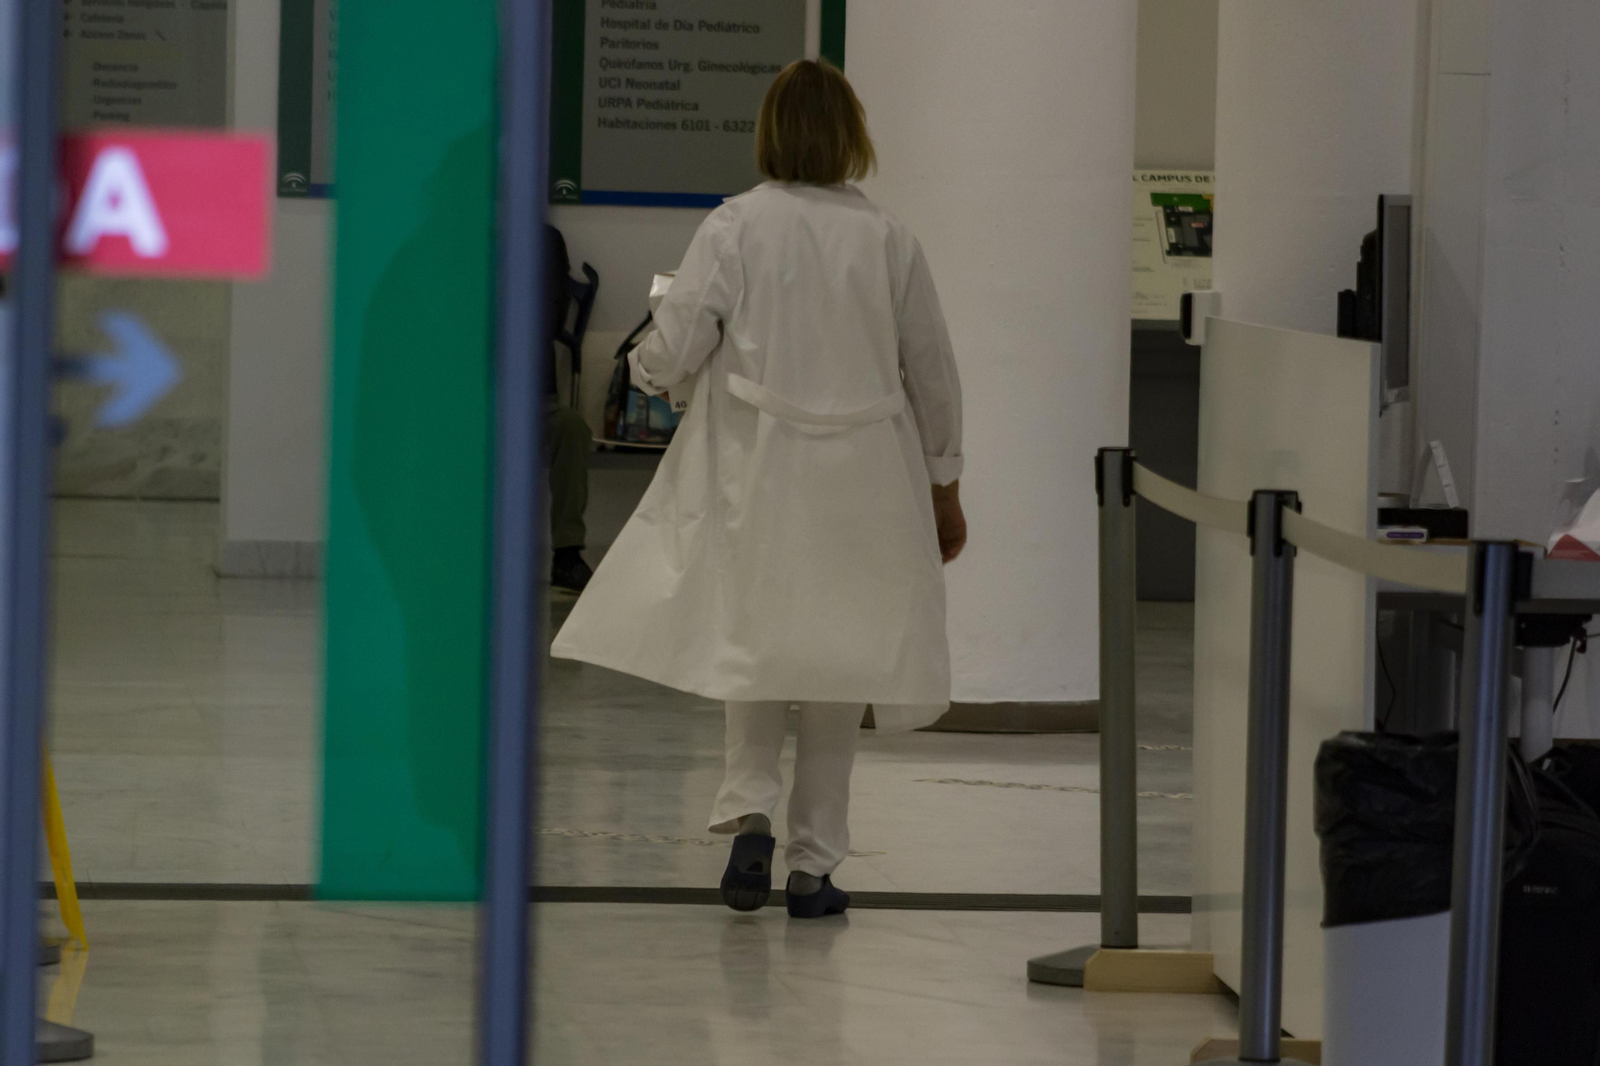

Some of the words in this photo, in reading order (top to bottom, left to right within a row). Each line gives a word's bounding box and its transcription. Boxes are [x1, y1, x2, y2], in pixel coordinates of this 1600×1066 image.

[600, 17, 650, 32] Hospital
[654, 18, 669, 30] de
[698, 20, 760, 34] Pediátrico
[600, 36, 660, 50] Paritorios
[600, 57, 664, 71] Quirófanos
[668, 59, 693, 74] Urg.
[698, 60, 782, 75] Ginecológicas
[598, 77, 621, 89] UCI
[625, 78, 681, 91] Neonatal
[598, 97, 633, 109] URPA
[636, 98, 699, 112] Pediátrica
[597, 117, 677, 131] Habitaciones
[681, 120, 711, 132] 6101
[722, 120, 755, 133] 6322
[1141, 173, 1192, 183] CAMPUS
[1194, 175, 1210, 183] DE
